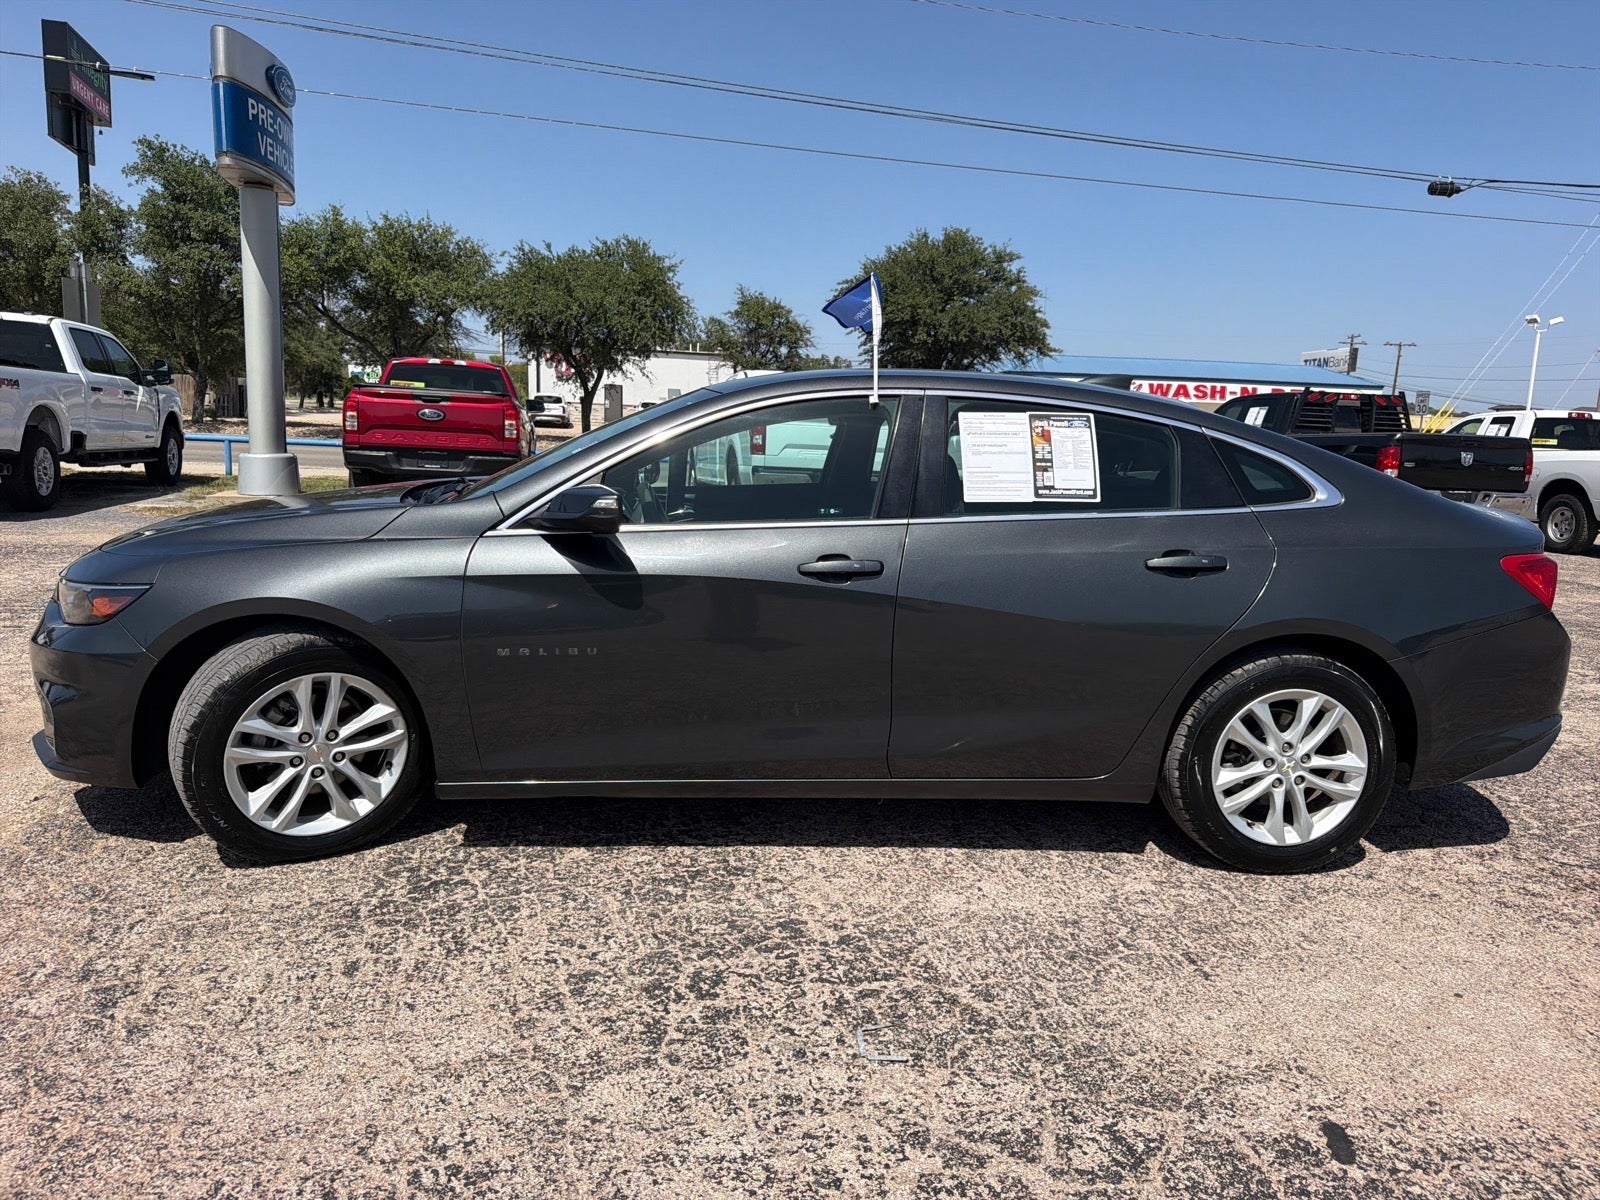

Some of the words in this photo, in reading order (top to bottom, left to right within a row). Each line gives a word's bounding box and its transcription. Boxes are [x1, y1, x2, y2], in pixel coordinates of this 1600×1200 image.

[71, 75, 94, 105] URGENT
[95, 97, 109, 118] CARE
[257, 131, 294, 177] VEHICLE
[1416, 404, 1427, 414] 30
[371, 432, 493, 447] RANGER
[496, 647, 597, 656] MALIBU
